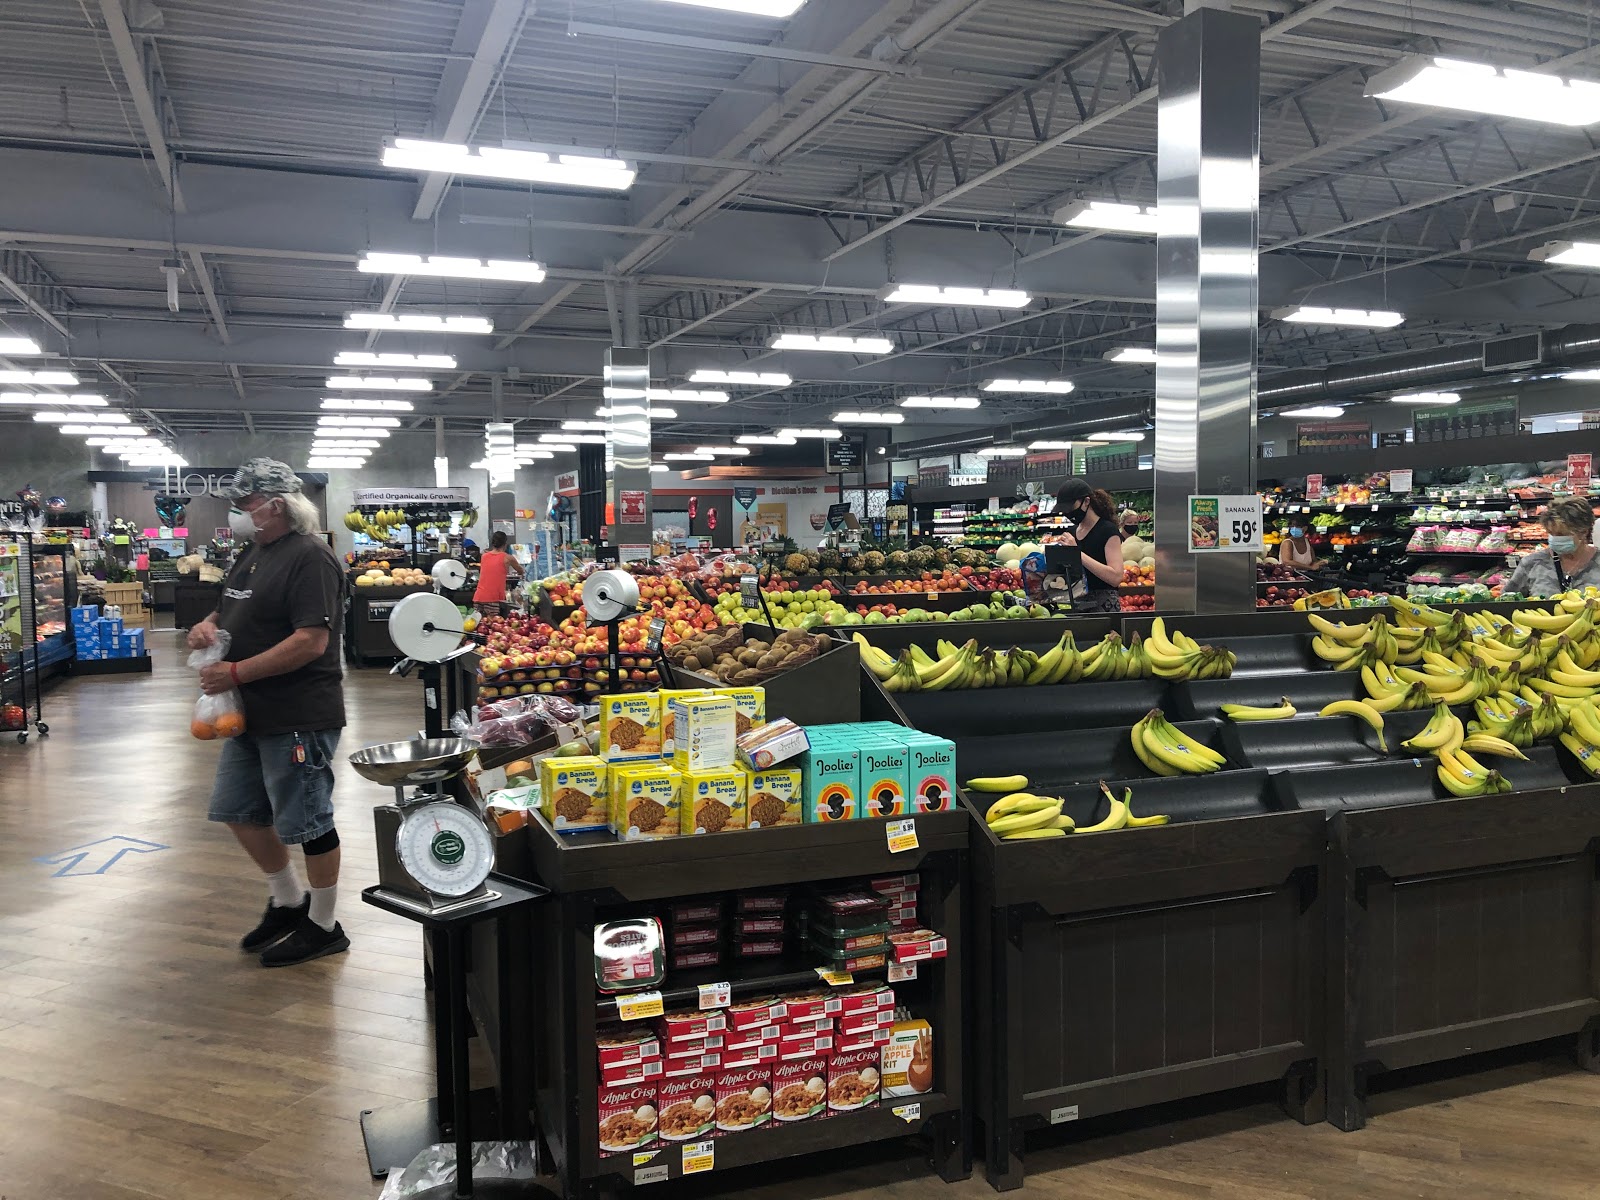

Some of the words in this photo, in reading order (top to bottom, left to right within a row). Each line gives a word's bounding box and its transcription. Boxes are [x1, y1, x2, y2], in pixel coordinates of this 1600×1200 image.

[1263, 447, 1273, 458] KS
[816, 758, 853, 776] Joolies
[867, 755, 902, 772] Joolies
[916, 751, 950, 768] Joolies
[903, 823, 913, 832] 8.99
[830, 1055, 856, 1066] Apple
[856, 1051, 879, 1062] Crisp
[884, 1050, 911, 1060] APPLE
[775, 1065, 801, 1077] Apple
[802, 1061, 825, 1072] Crisp
[884, 1060, 897, 1069] KIT
[661, 1082, 688, 1094] Apple
[690, 1078, 714, 1089] Crisp
[718, 1074, 746, 1086] Apple
[746, 1070, 770, 1080] Crisp
[601, 1093, 630, 1104] Apple
[631, 1088, 656, 1099] Crisp
[701, 1144, 713, 1152] 1.99
